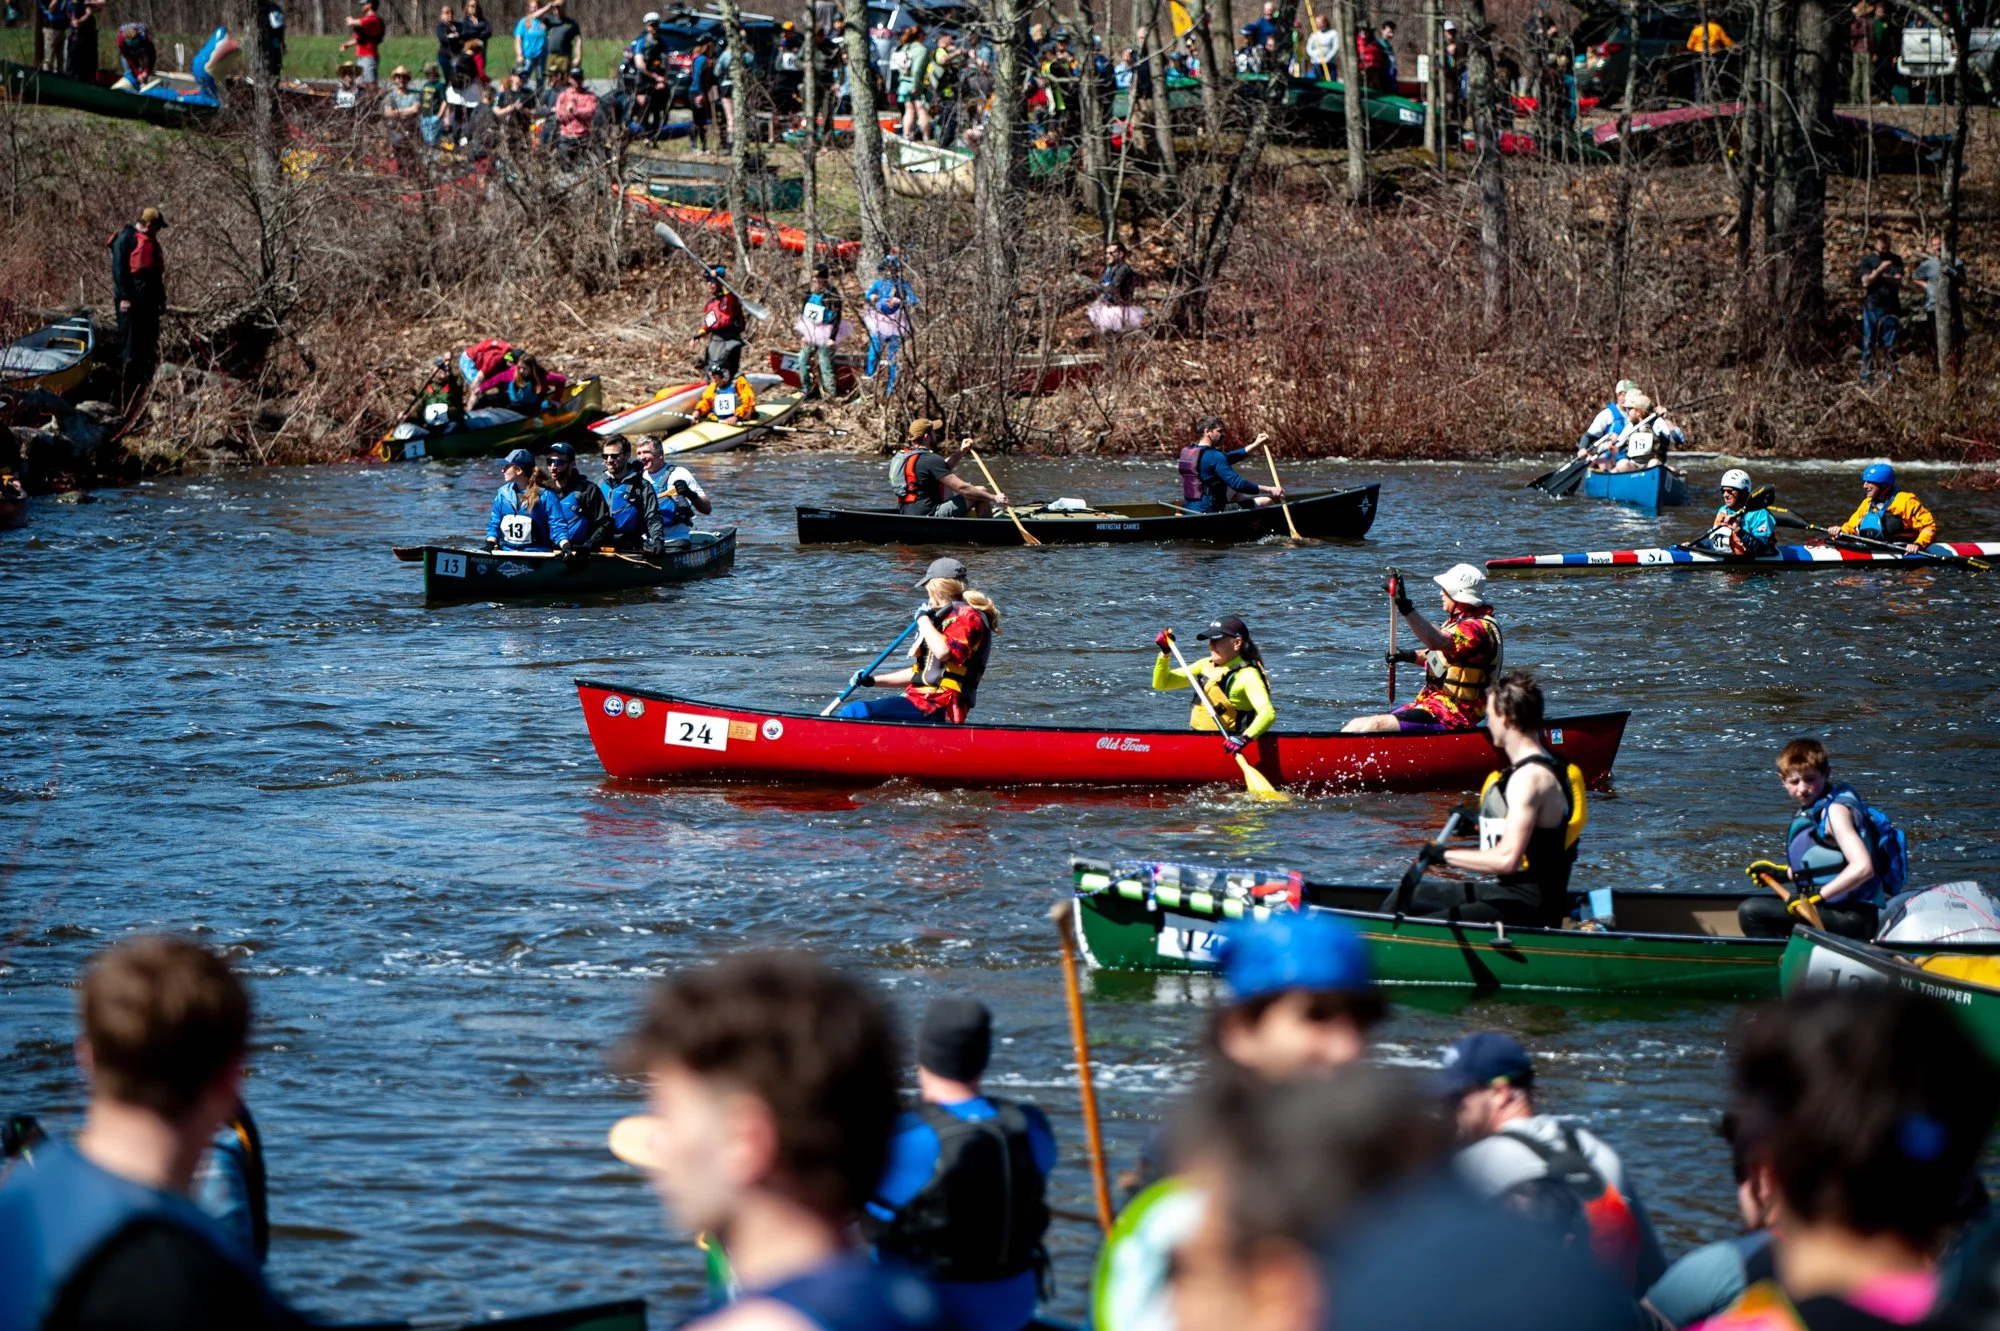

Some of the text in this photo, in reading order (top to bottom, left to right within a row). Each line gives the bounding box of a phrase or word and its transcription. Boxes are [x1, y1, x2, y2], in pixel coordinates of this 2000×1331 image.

[508, 523, 523, 539] 13
[443, 559, 459, 574] 13
[679, 722, 713, 744] 24
[1096, 736, 1150, 752] Old Town
[1900, 976, 1973, 1006] XL TRIPPER
